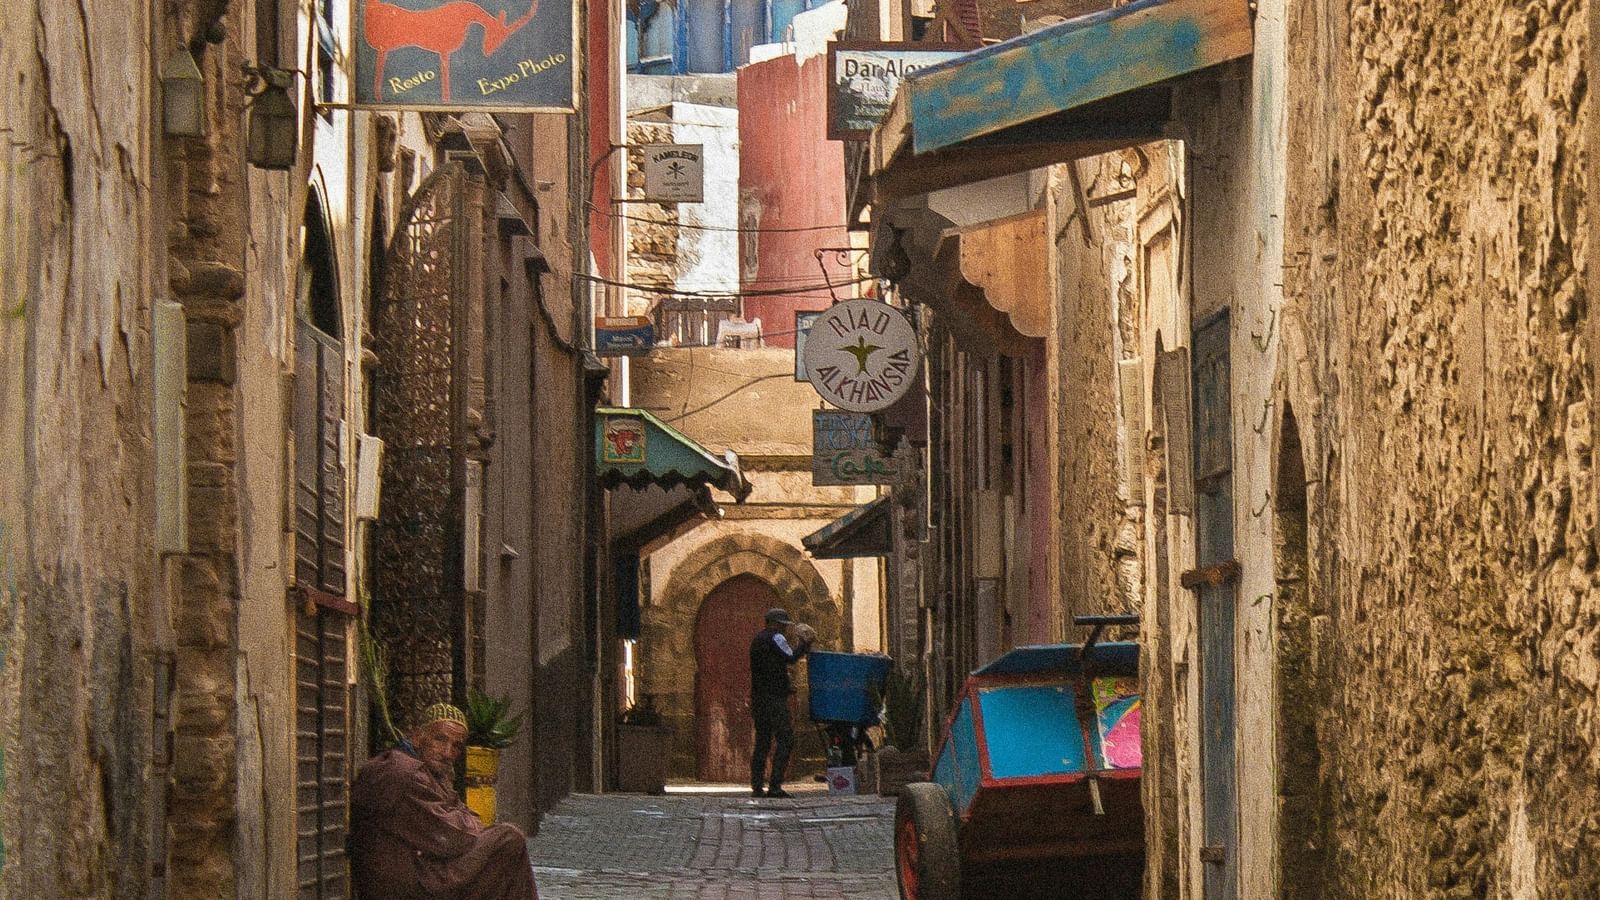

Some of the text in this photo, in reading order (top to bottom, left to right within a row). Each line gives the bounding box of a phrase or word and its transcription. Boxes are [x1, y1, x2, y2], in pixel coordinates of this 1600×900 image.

[476, 53, 566, 95] Expo Photo
[845, 59, 882, 78] Dar
[389, 70, 435, 94] Resto
